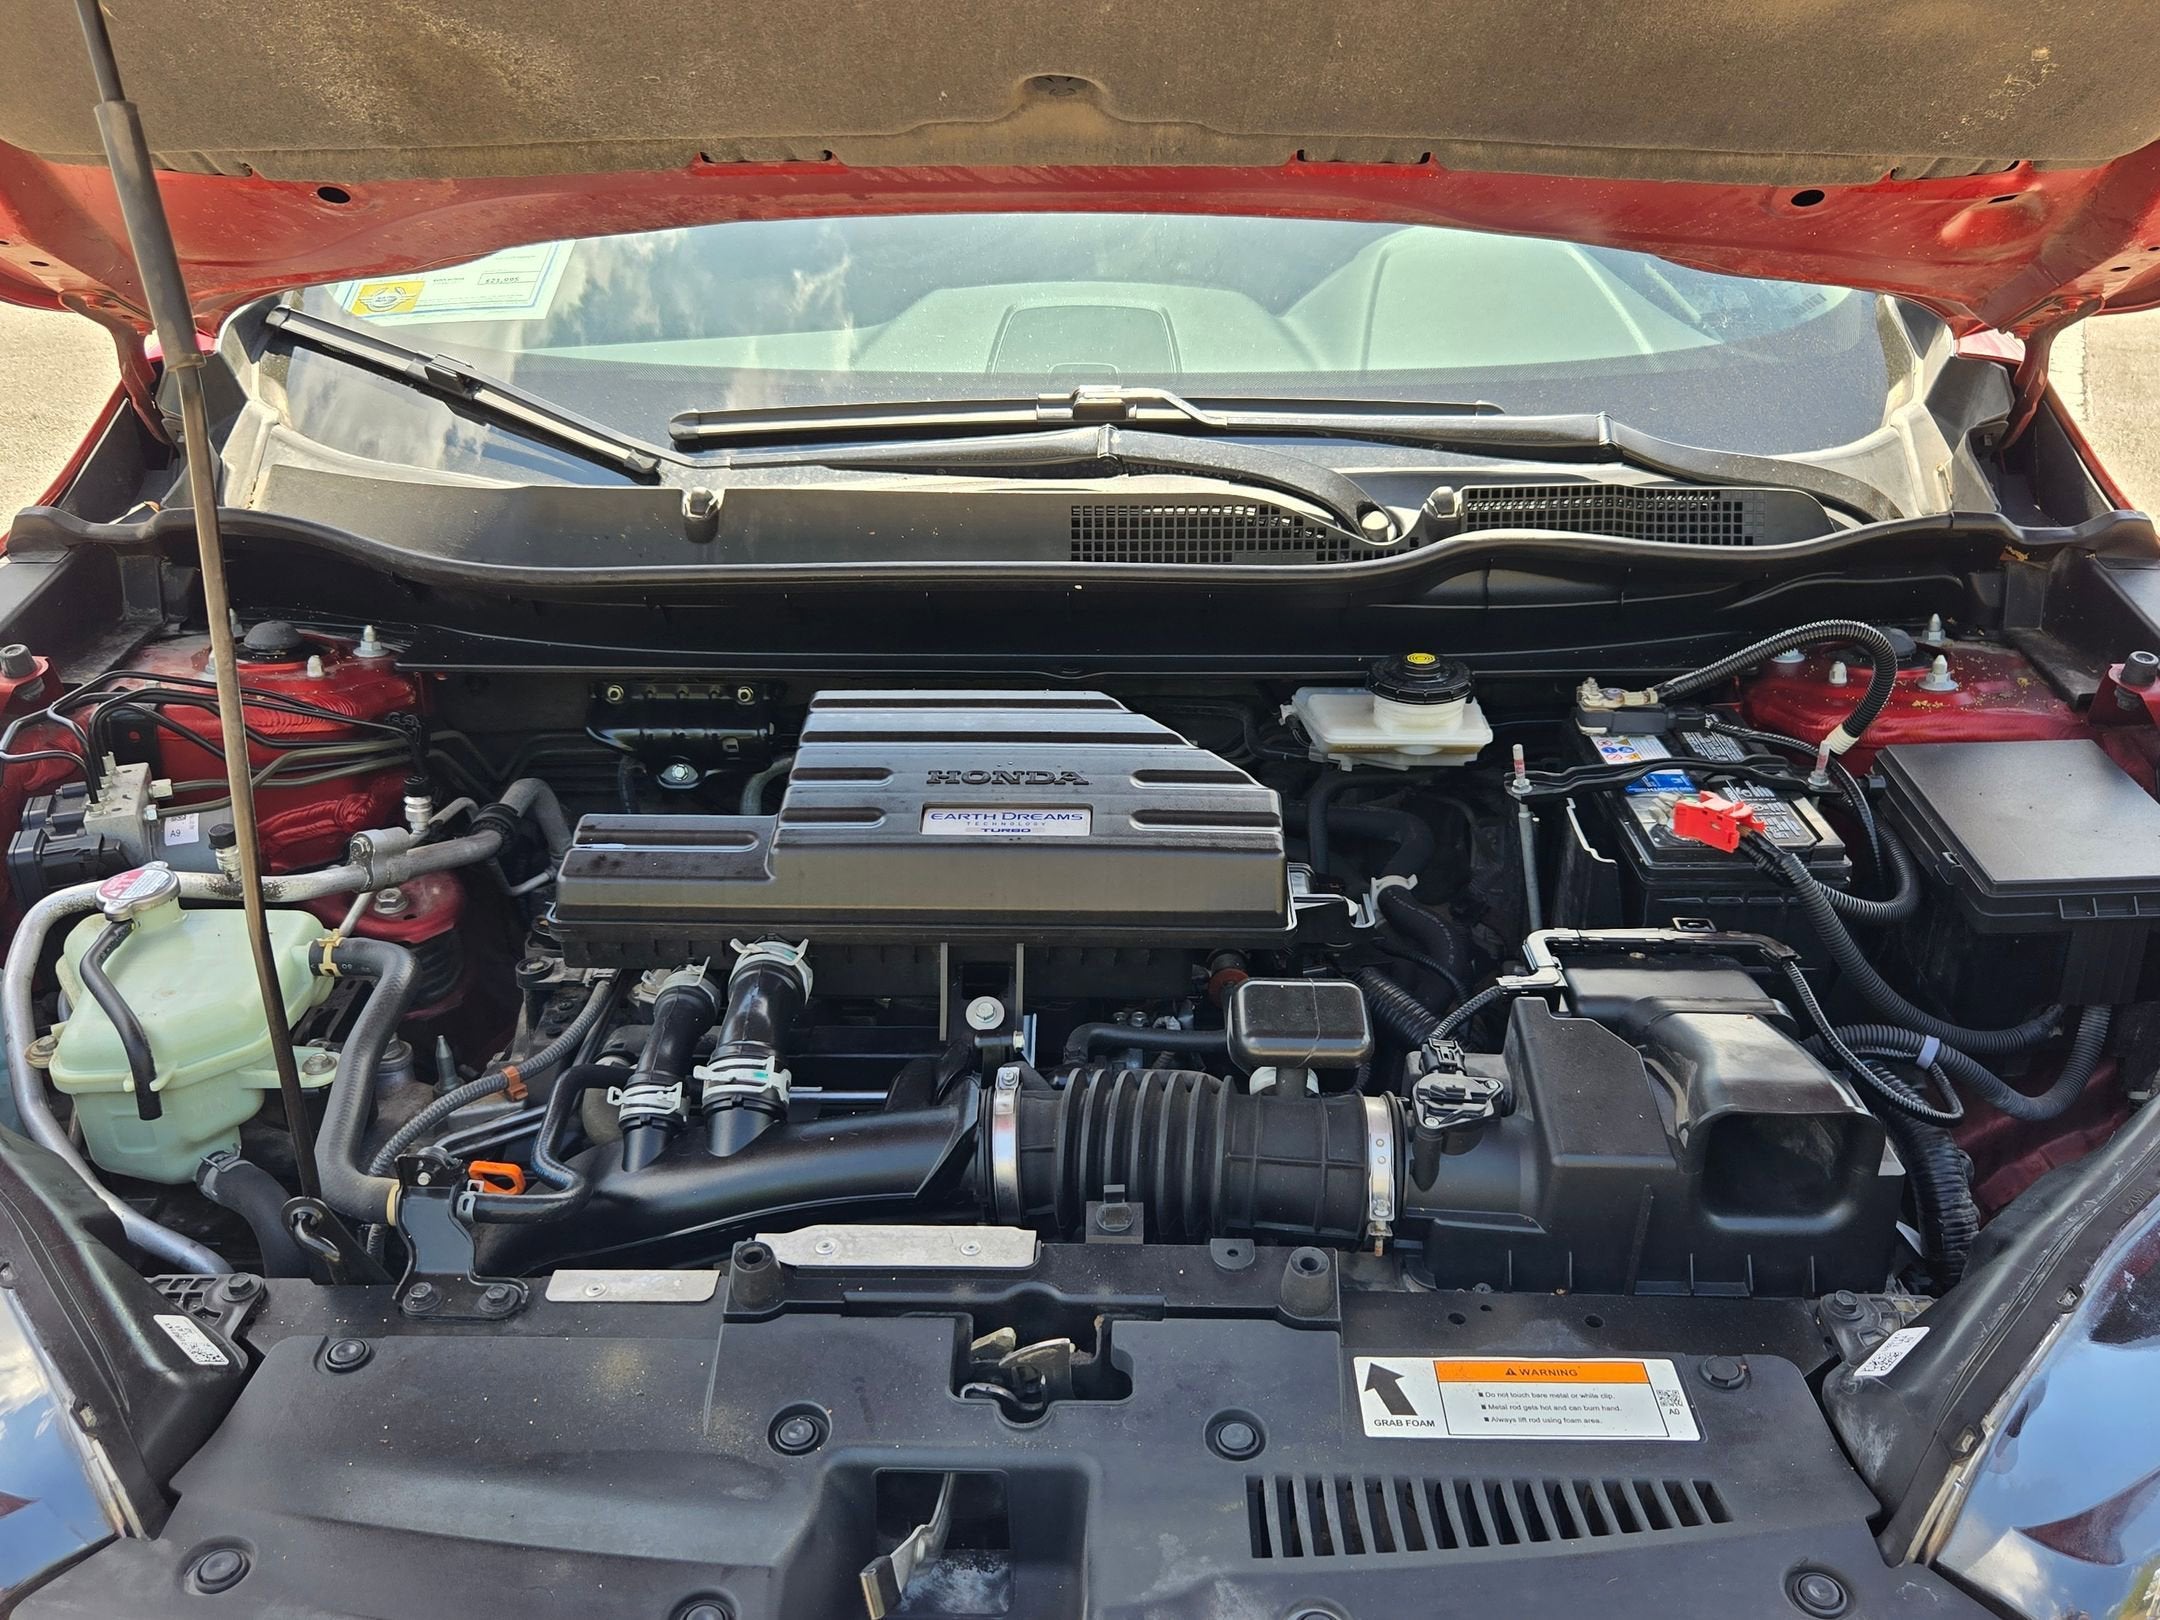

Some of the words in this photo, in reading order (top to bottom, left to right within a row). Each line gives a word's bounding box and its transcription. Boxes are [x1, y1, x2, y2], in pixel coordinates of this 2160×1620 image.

[926, 769, 1090, 786] HONDA
[930, 812, 997, 821] EARTH
[1001, 811, 1084, 821] DREAMS
[170, 829, 181, 837] A9
[1518, 1368, 1578, 1377] WARNING
[1523, 1404, 1539, 1412] gets
[1373, 1419, 1404, 1427] GRAB
[1405, 1419, 1436, 1427] FOAM
[1491, 1416, 1517, 1424] Always
[1542, 1417, 1562, 1425] using
